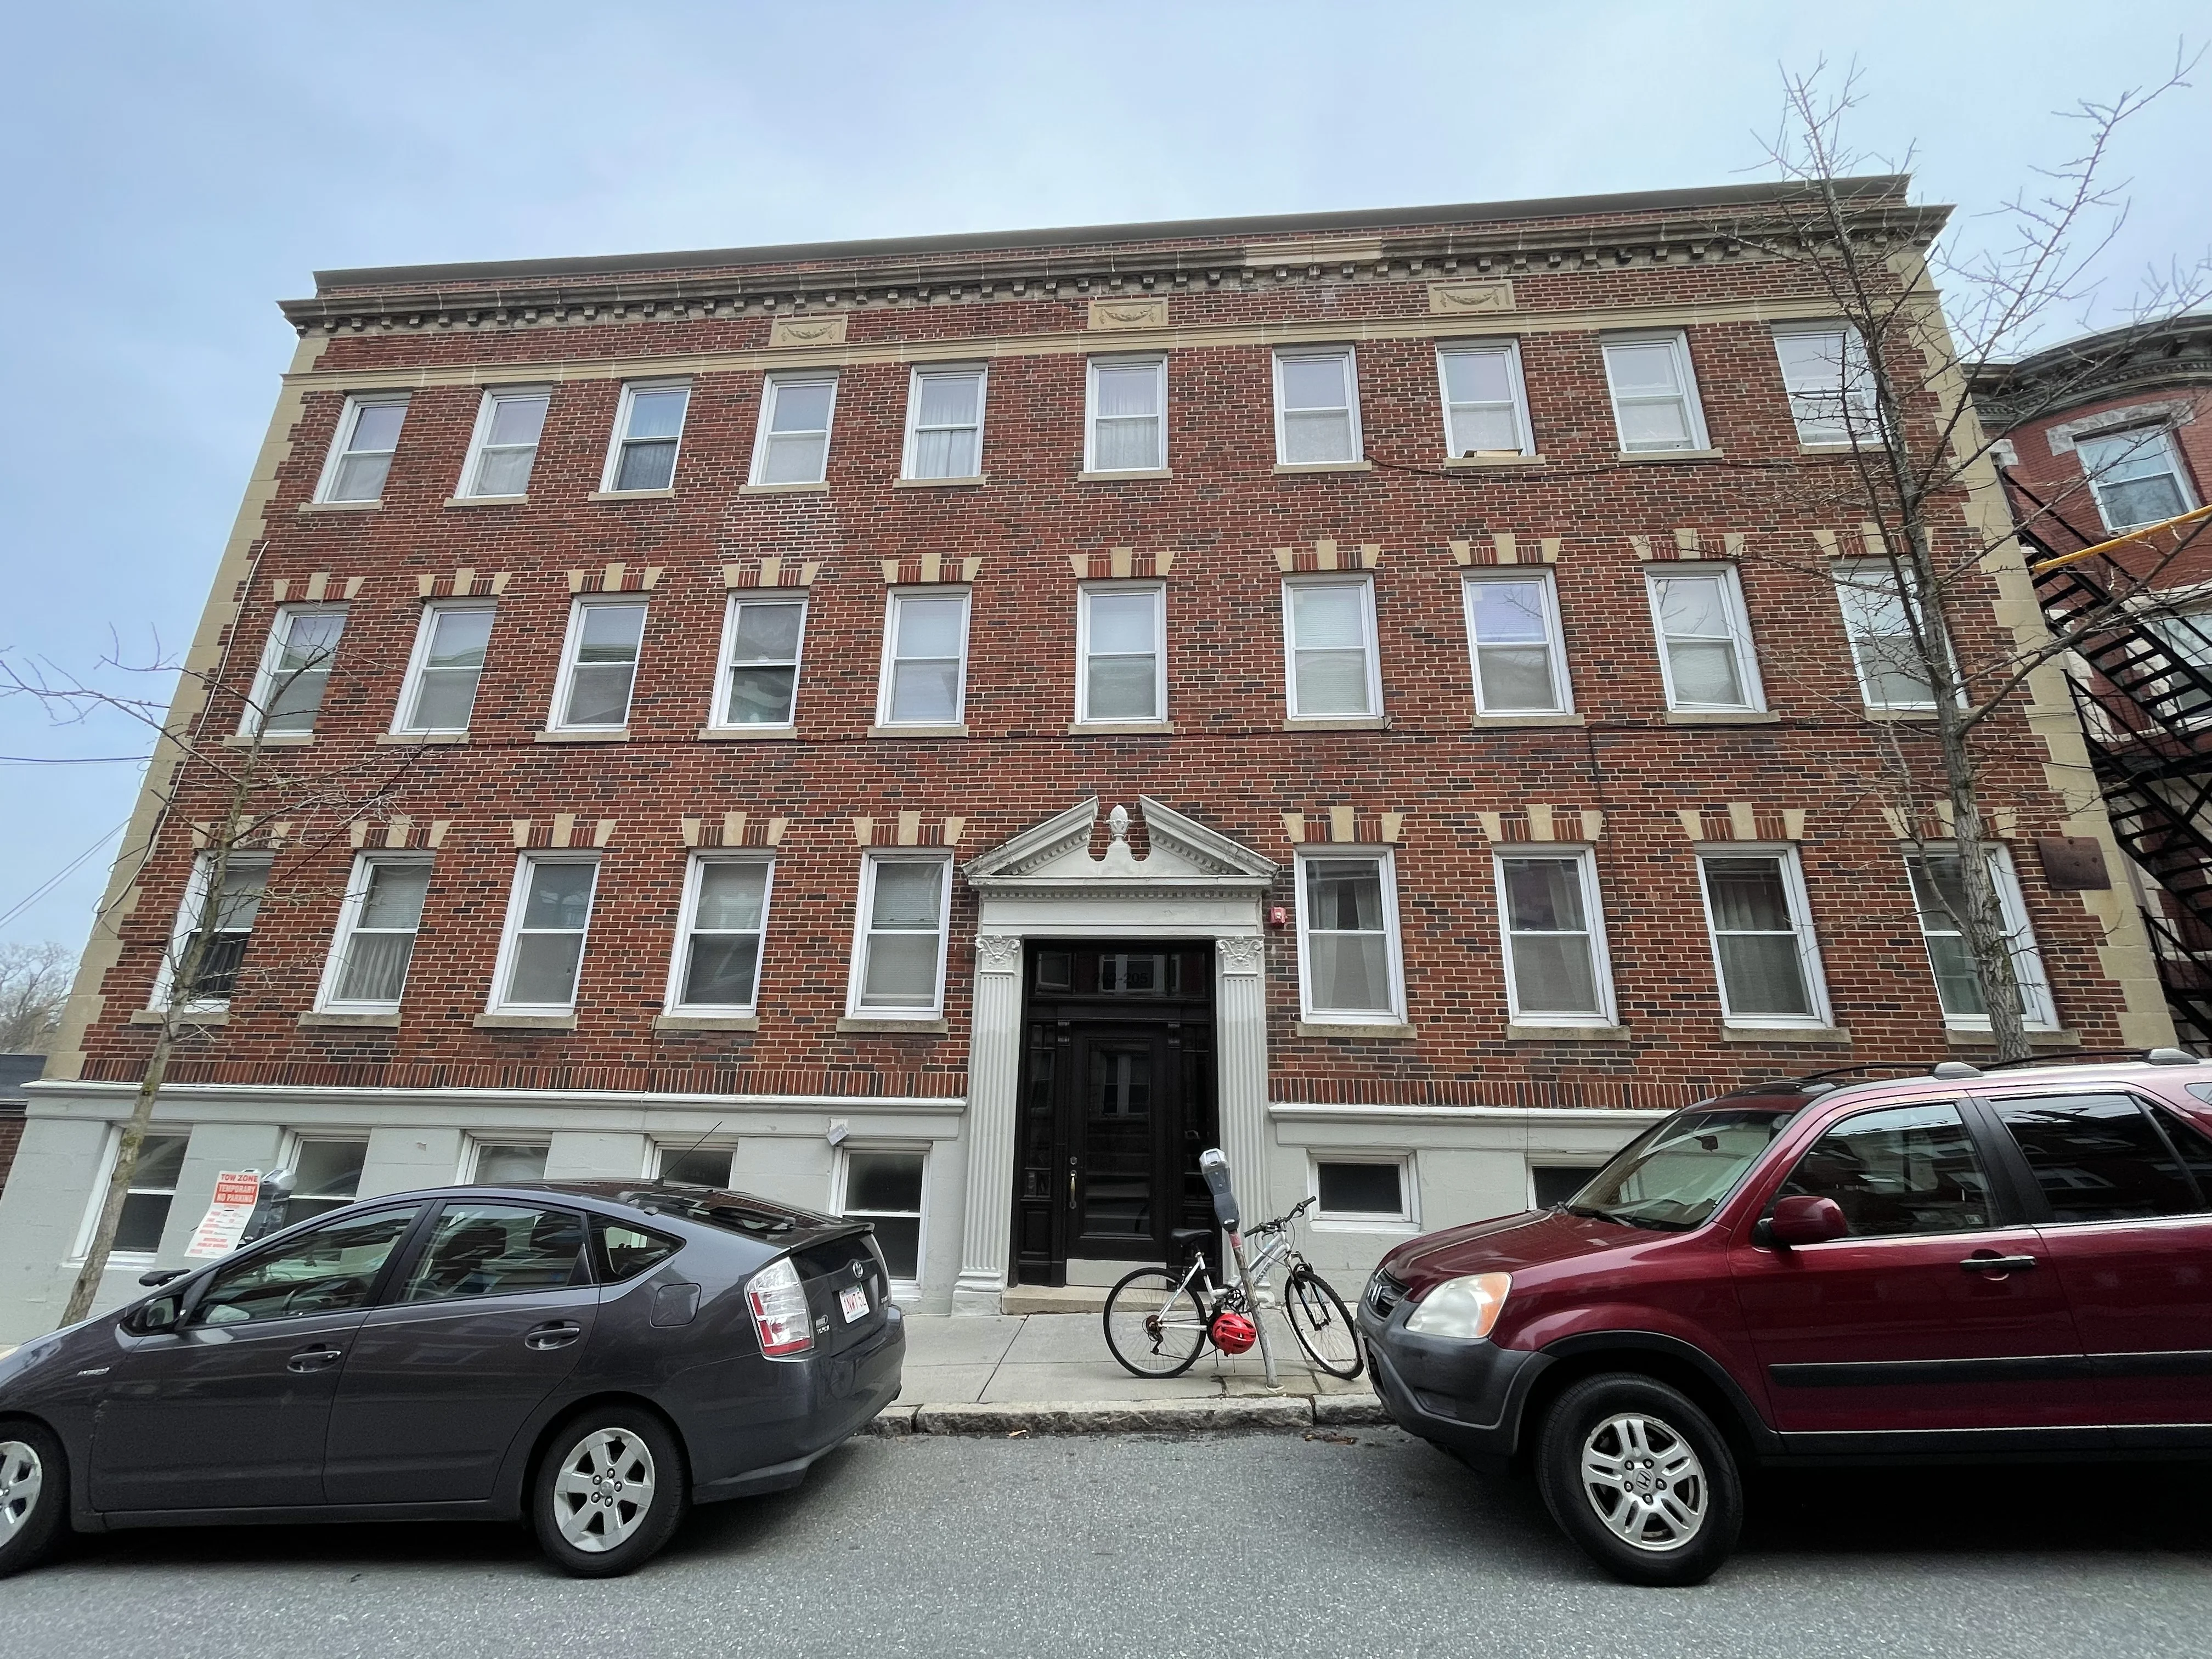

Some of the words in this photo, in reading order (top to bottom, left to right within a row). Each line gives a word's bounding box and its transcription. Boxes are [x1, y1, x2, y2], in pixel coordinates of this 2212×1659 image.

[219, 1184, 256, 1194] TEMPORARY
[217, 1193, 227, 1201] NO
[227, 1194, 254, 1203] PARKING
